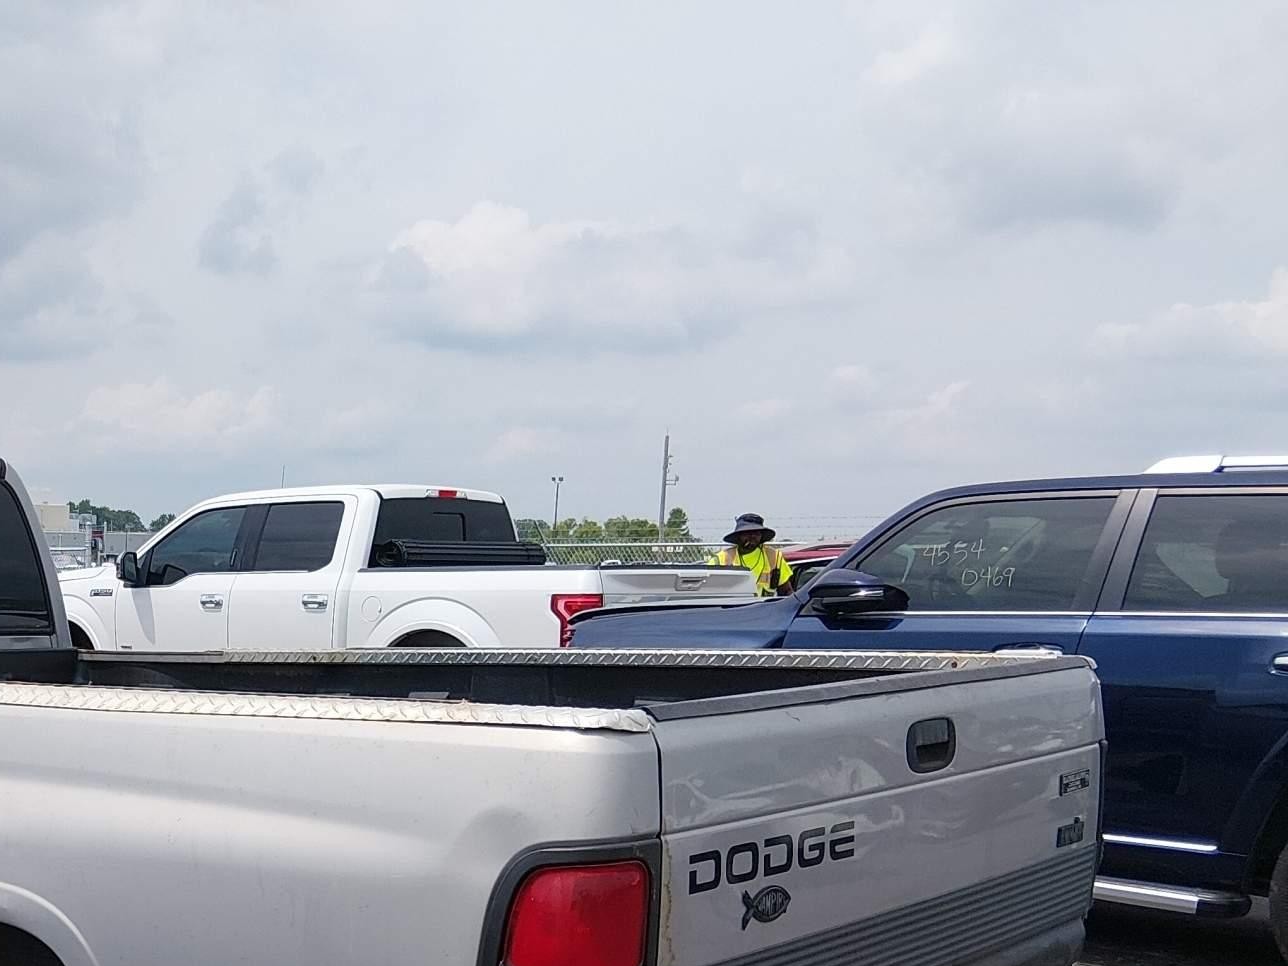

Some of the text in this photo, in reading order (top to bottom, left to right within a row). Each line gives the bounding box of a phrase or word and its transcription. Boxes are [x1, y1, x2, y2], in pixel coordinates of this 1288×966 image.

[923, 538, 987, 567] 4554
[961, 566, 1016, 588] 0469
[688, 820, 856, 896] DODGE
